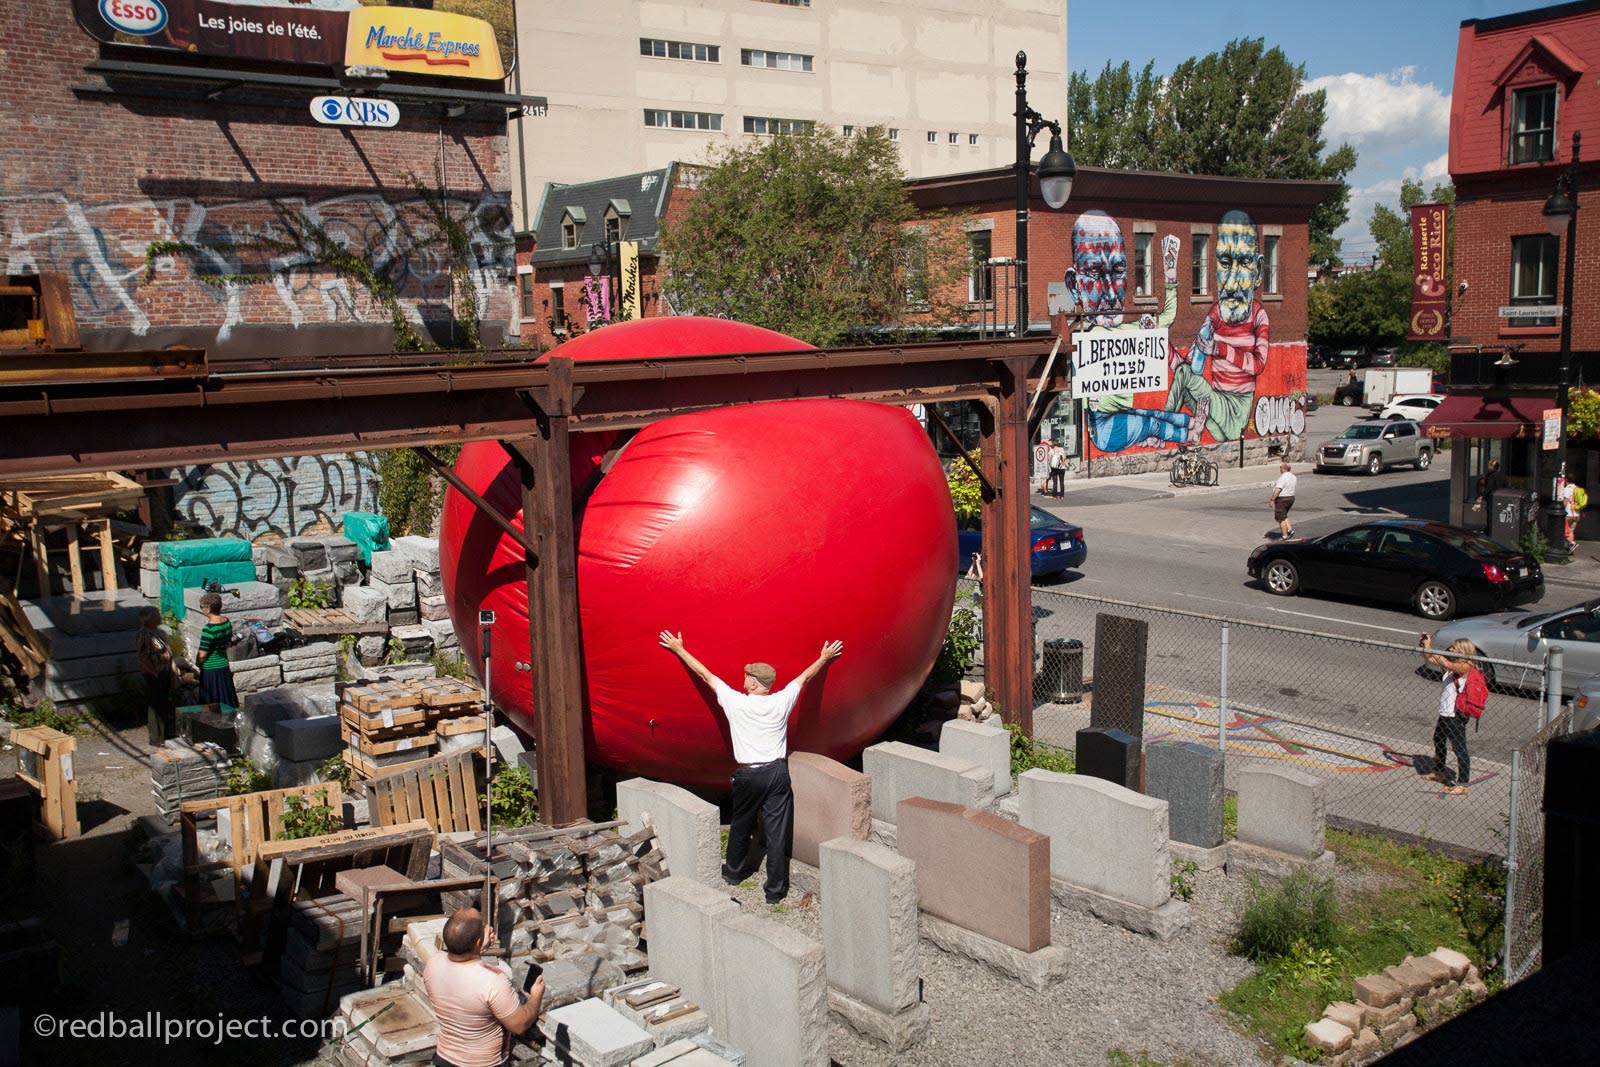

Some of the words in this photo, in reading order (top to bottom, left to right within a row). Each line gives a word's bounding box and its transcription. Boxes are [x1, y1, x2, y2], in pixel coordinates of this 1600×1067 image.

[198, 12, 226, 29] Les
[227, 16, 264, 34] joies
[267, 20, 285, 35] de
[287, 22, 322, 40] l'été.
[425, 31, 481, 57] Express
[345, 101, 390, 124] CBS
[522, 104, 546, 117] 2415
[1430, 211, 1441, 249] Rico
[1081, 375, 1161, 393] MONUMENTS
